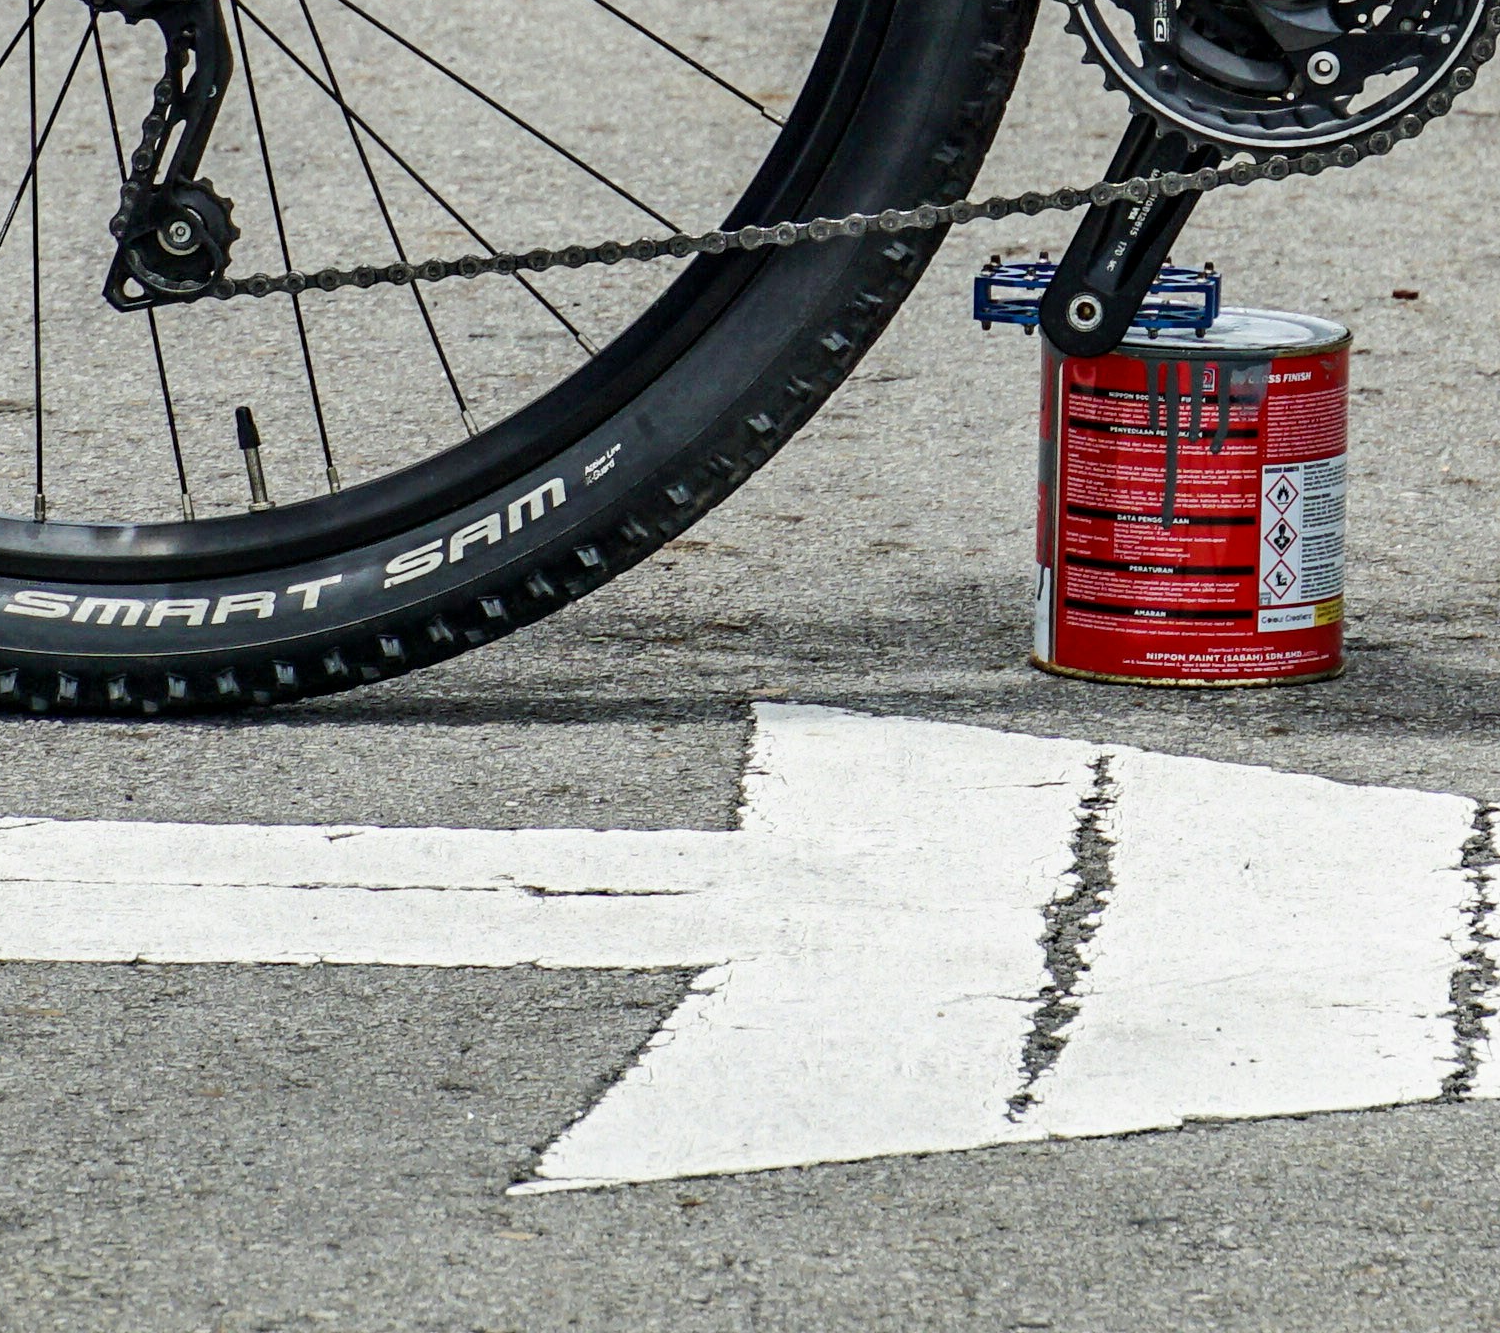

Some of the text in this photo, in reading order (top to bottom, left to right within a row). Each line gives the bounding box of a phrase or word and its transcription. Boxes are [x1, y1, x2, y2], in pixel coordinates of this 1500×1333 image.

[3, 475, 568, 628] SMART SAM
[1128, 565, 1174, 574] PERATURAN
[1146, 652, 1187, 662] NIPPON
[1188, 653, 1221, 663] PAINT
[1223, 653, 1264, 663] (SABAH)
